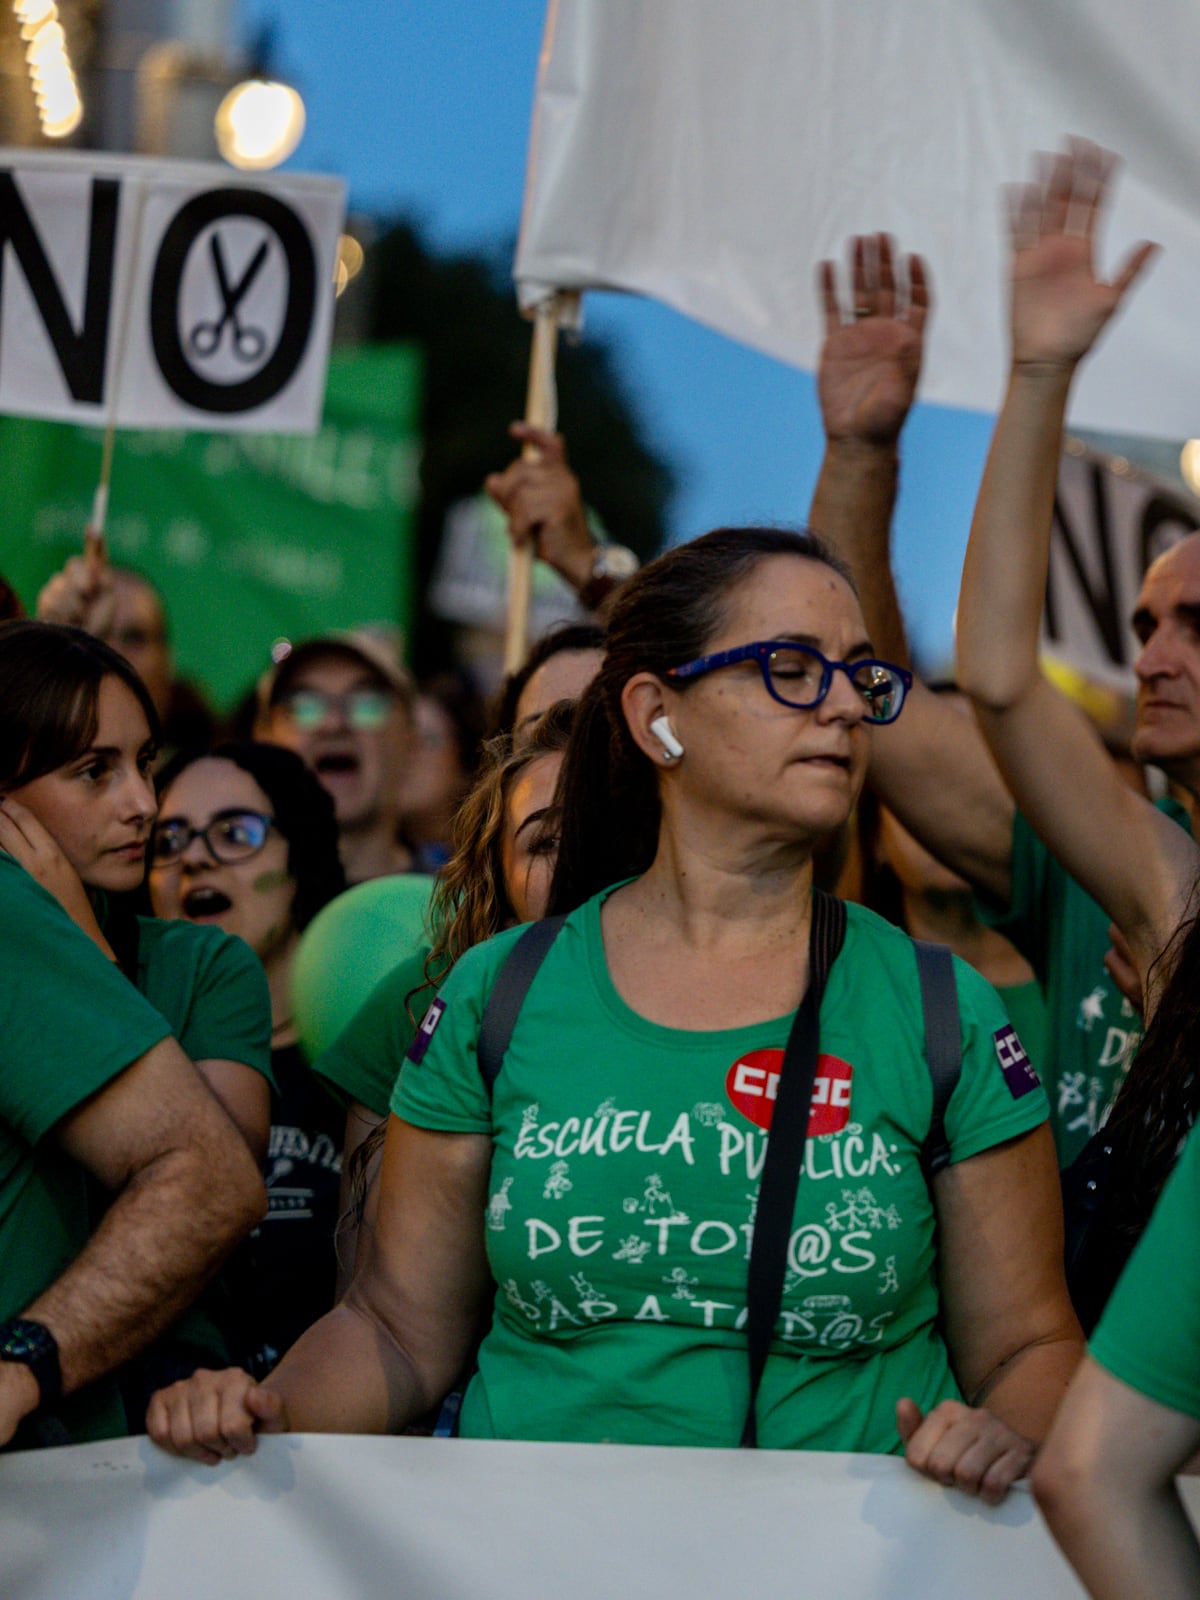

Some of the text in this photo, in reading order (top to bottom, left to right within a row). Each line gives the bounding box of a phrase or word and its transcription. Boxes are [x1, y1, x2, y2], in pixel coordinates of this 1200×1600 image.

[0, 168, 317, 414] NO
[514, 1110, 695, 1166] ESCUELA
[525, 1215, 604, 1259] DE
